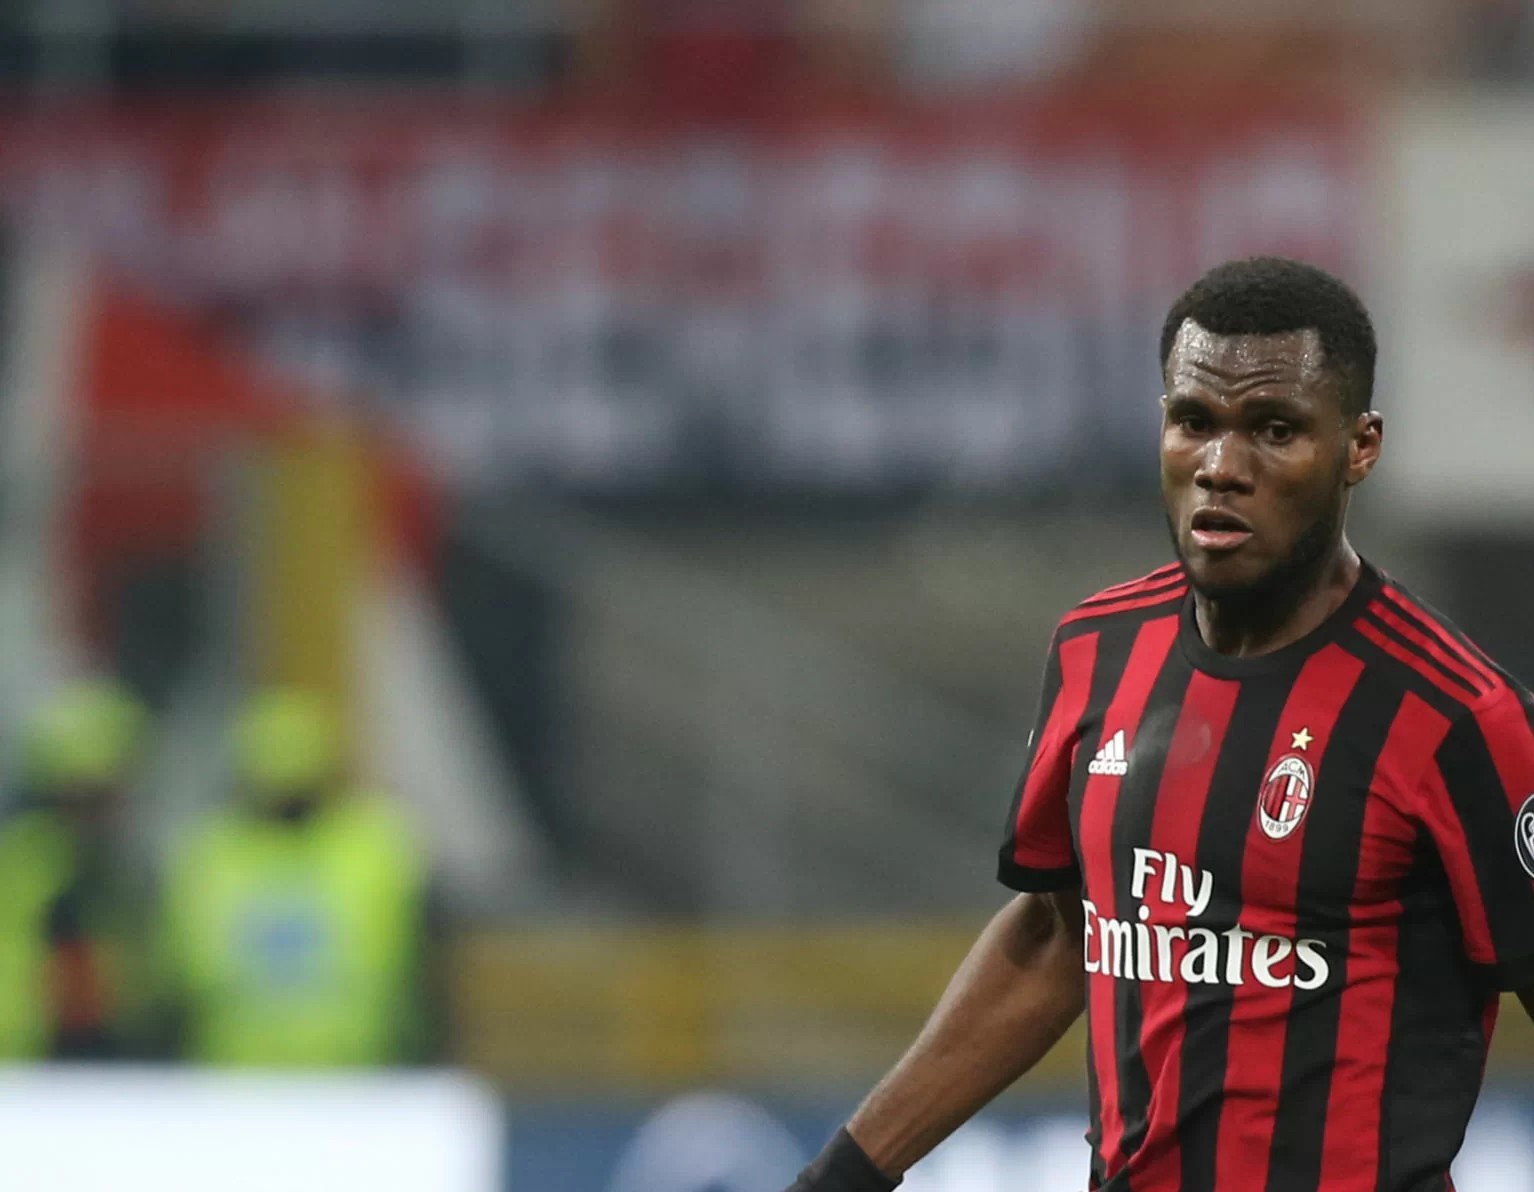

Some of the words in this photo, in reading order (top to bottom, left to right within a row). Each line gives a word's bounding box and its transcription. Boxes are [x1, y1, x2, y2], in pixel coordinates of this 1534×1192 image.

[1088, 757, 1128, 776] adidas
[1278, 760, 1306, 779] ACM
[1264, 820, 1290, 833] 1899
[1131, 847, 1214, 917] Fly
[1081, 898, 1330, 991] Emirates
